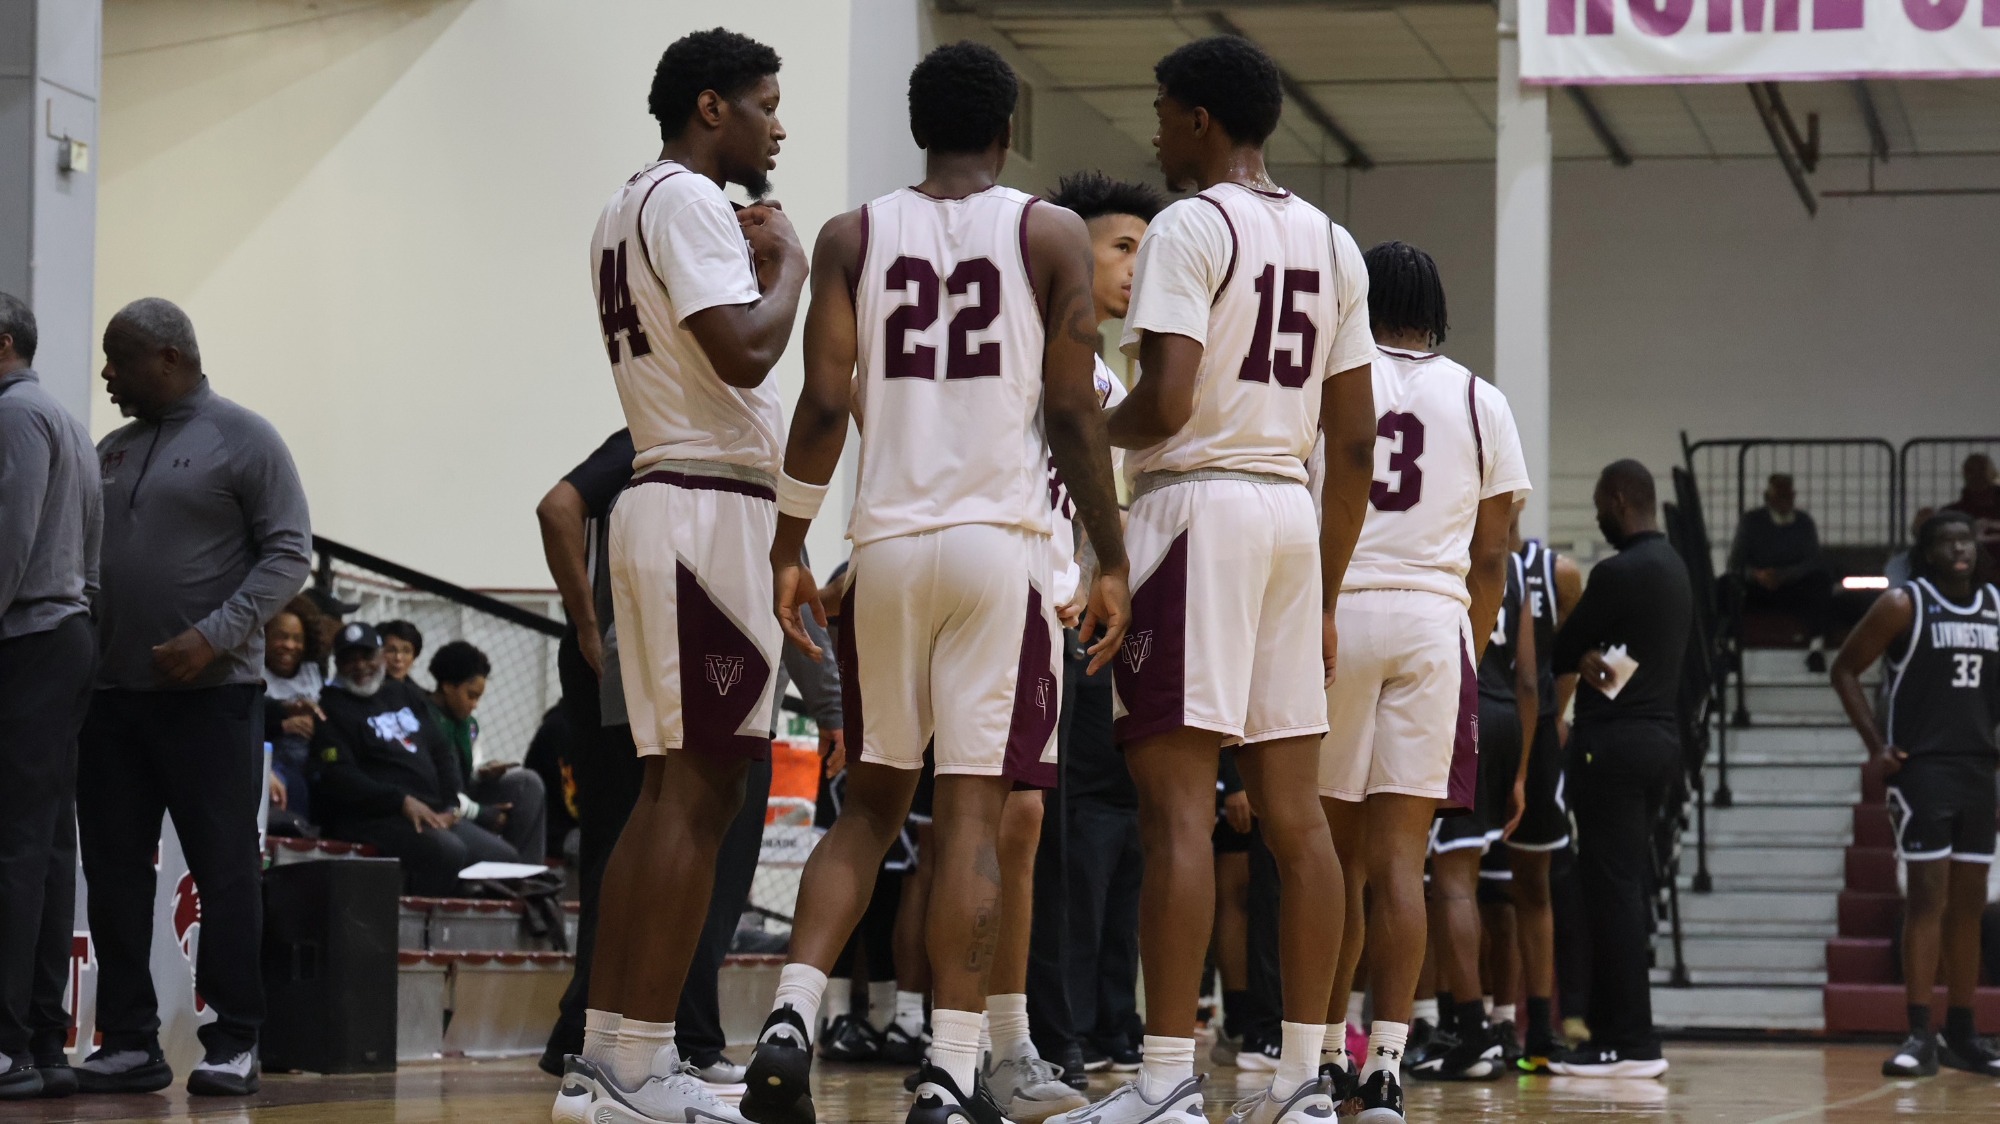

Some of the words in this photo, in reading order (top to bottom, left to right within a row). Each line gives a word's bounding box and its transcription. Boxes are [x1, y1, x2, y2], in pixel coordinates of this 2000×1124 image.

[599, 239, 652, 365] 44
[883, 254, 1002, 382] 22
[1237, 263, 1320, 391] 15
[1369, 409, 1425, 514] 3
[1951, 653, 1983, 688] 33
